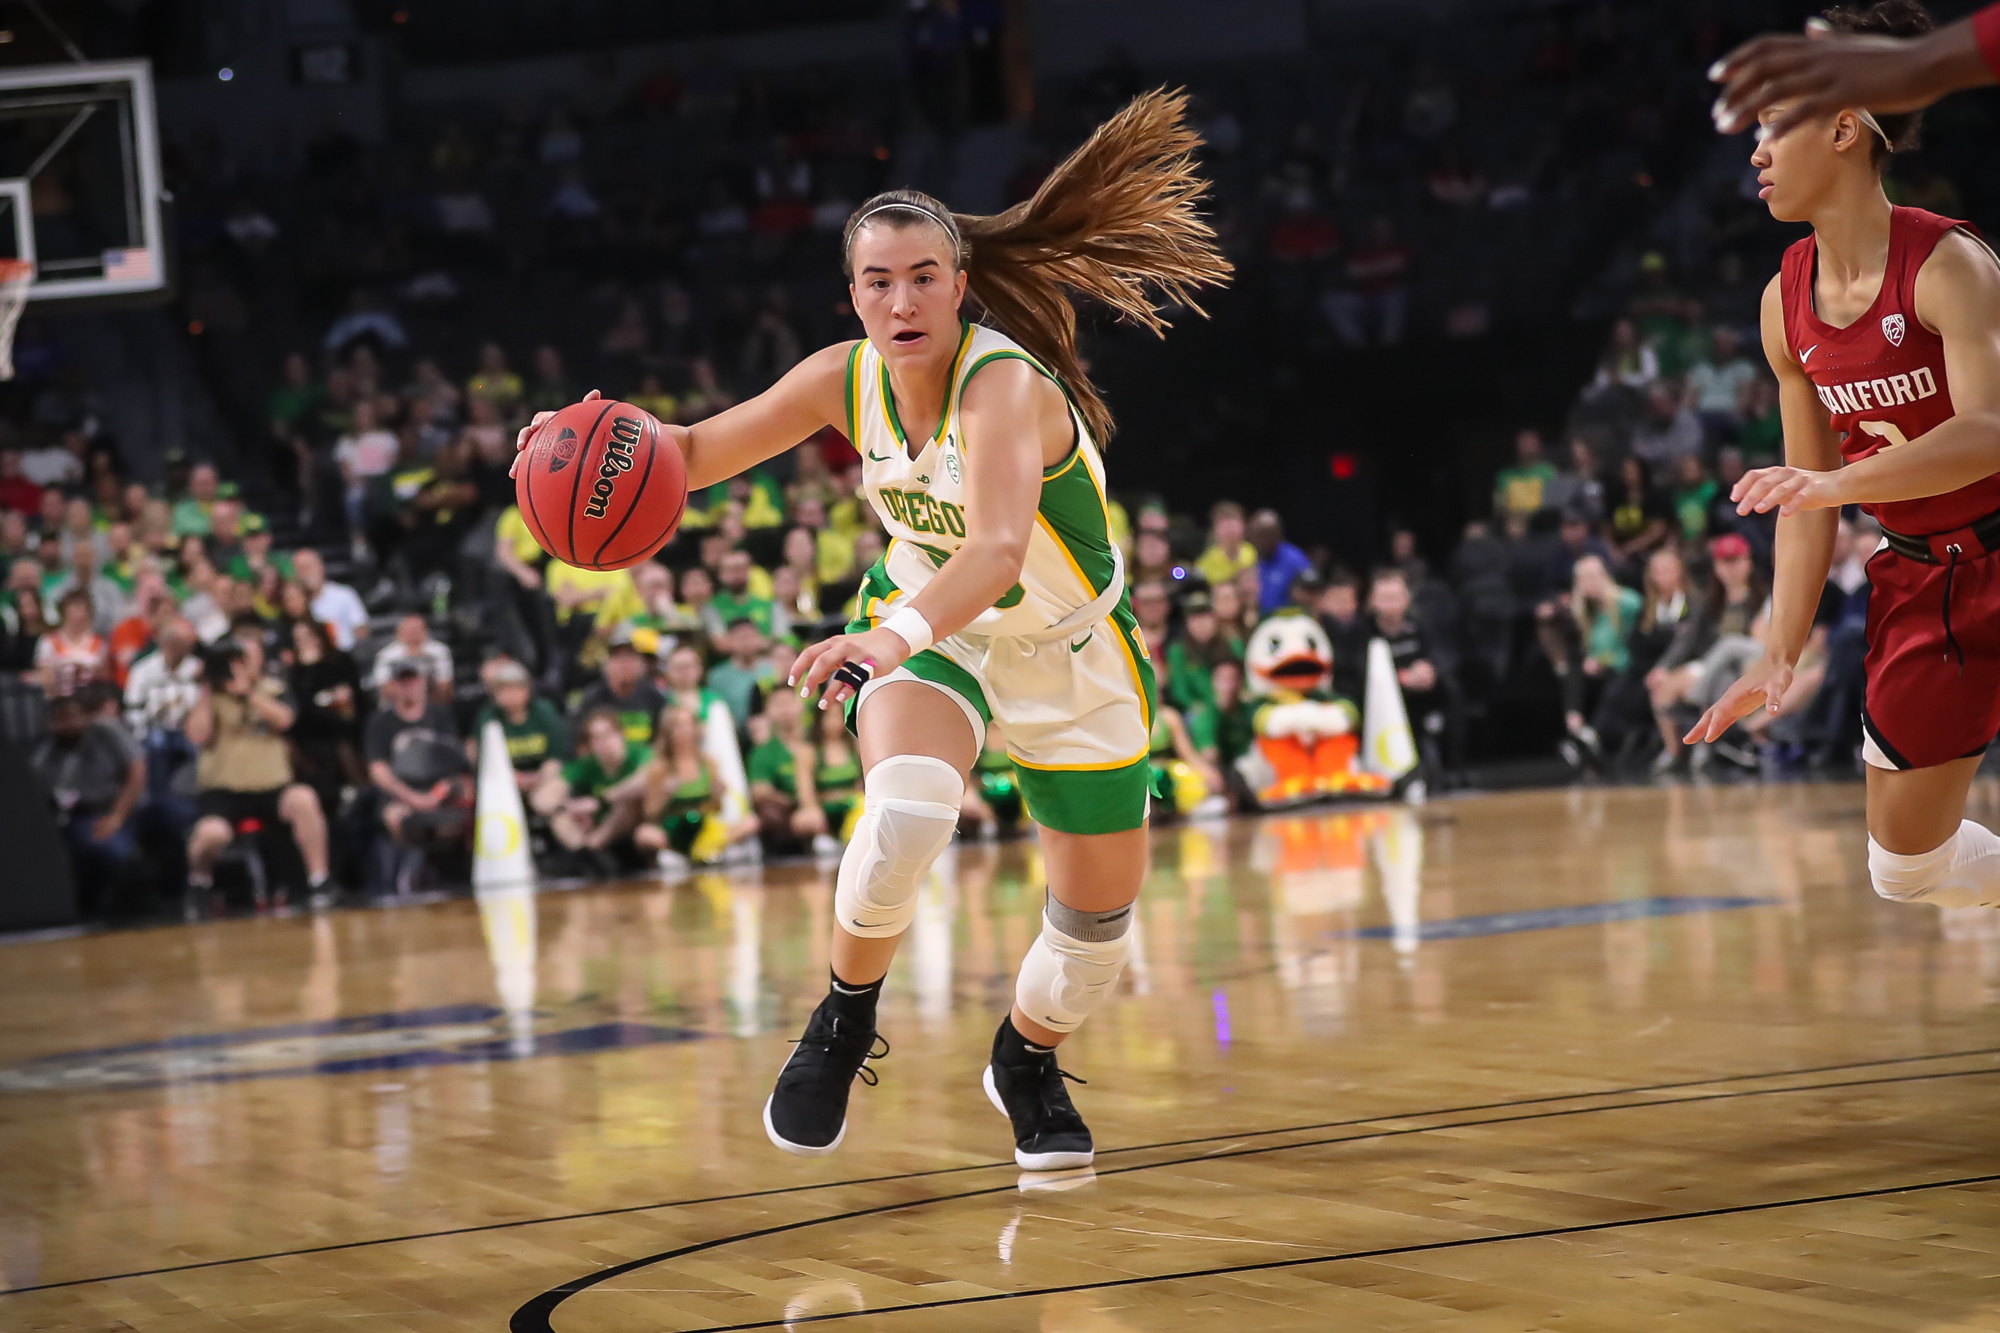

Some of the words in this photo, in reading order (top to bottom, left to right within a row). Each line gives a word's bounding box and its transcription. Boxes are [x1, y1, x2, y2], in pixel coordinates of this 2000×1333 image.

[1890, 328, 1901, 340] 12
[583, 416, 644, 519] Wilson
[879, 487, 967, 538] OREGO
